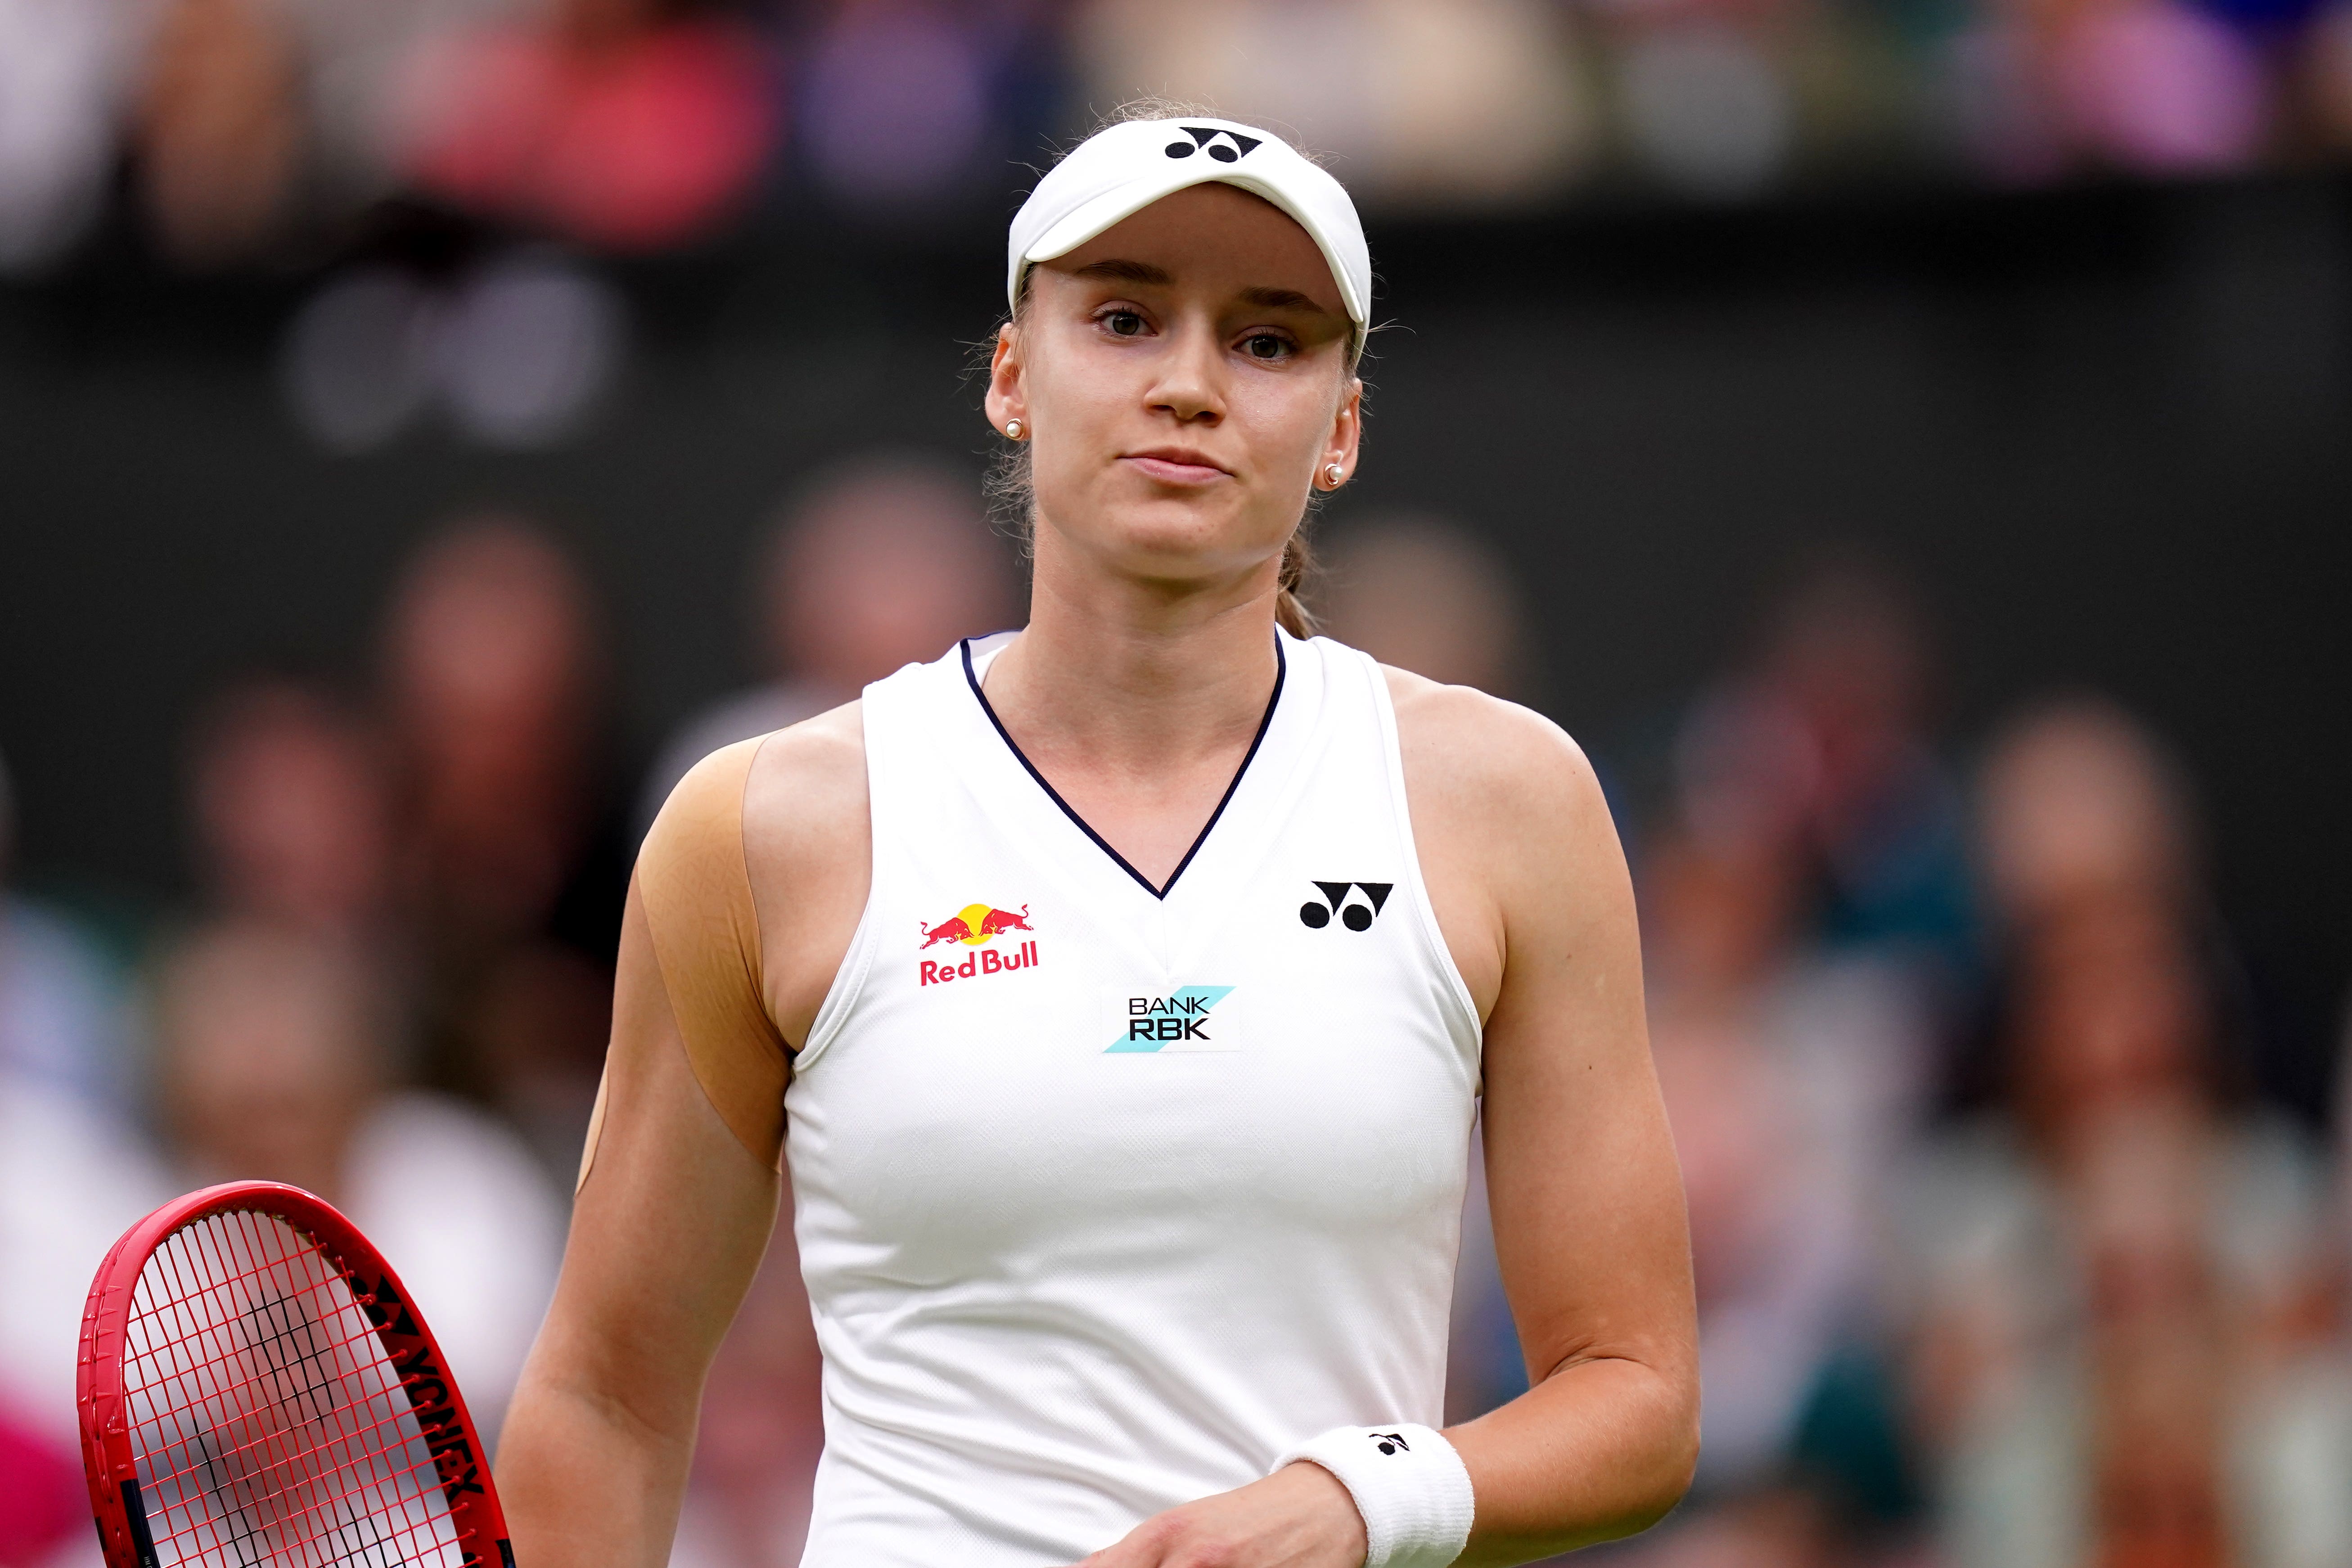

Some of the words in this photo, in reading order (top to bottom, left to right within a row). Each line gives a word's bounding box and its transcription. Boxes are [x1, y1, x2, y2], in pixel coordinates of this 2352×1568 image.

[920, 951, 976, 986] Red
[981, 941, 1038, 974] Bull
[1129, 997, 1210, 1015] BANK
[1130, 1018, 1211, 1041] RBK
[396, 1346, 485, 1504] YONEX
